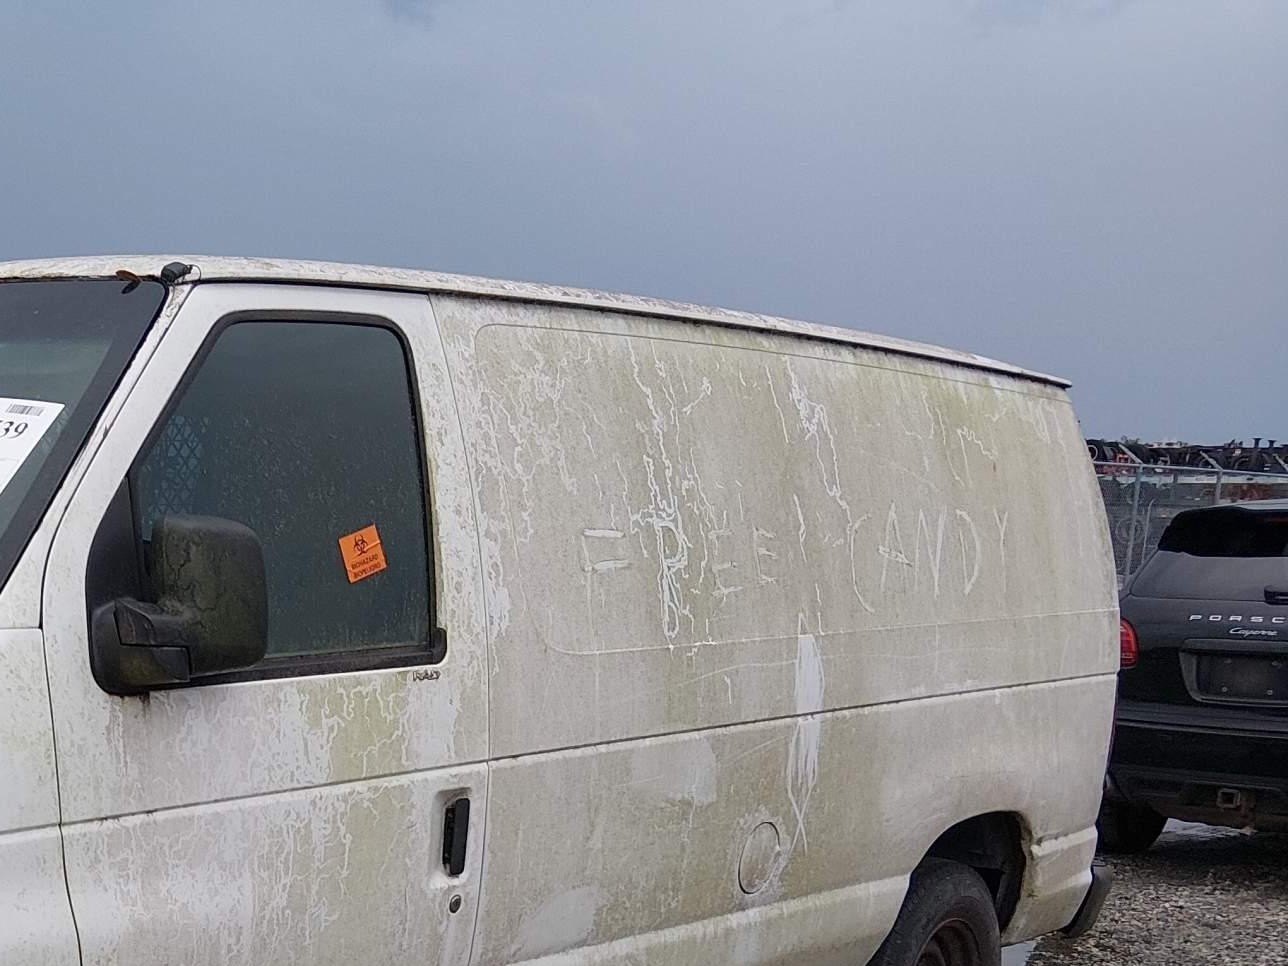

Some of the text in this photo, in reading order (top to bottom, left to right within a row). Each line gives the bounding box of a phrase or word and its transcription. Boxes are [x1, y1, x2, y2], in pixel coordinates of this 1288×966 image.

[580, 502, 1010, 626] FREE CANDY
[1229, 627, 1279, 638] Cayenne
